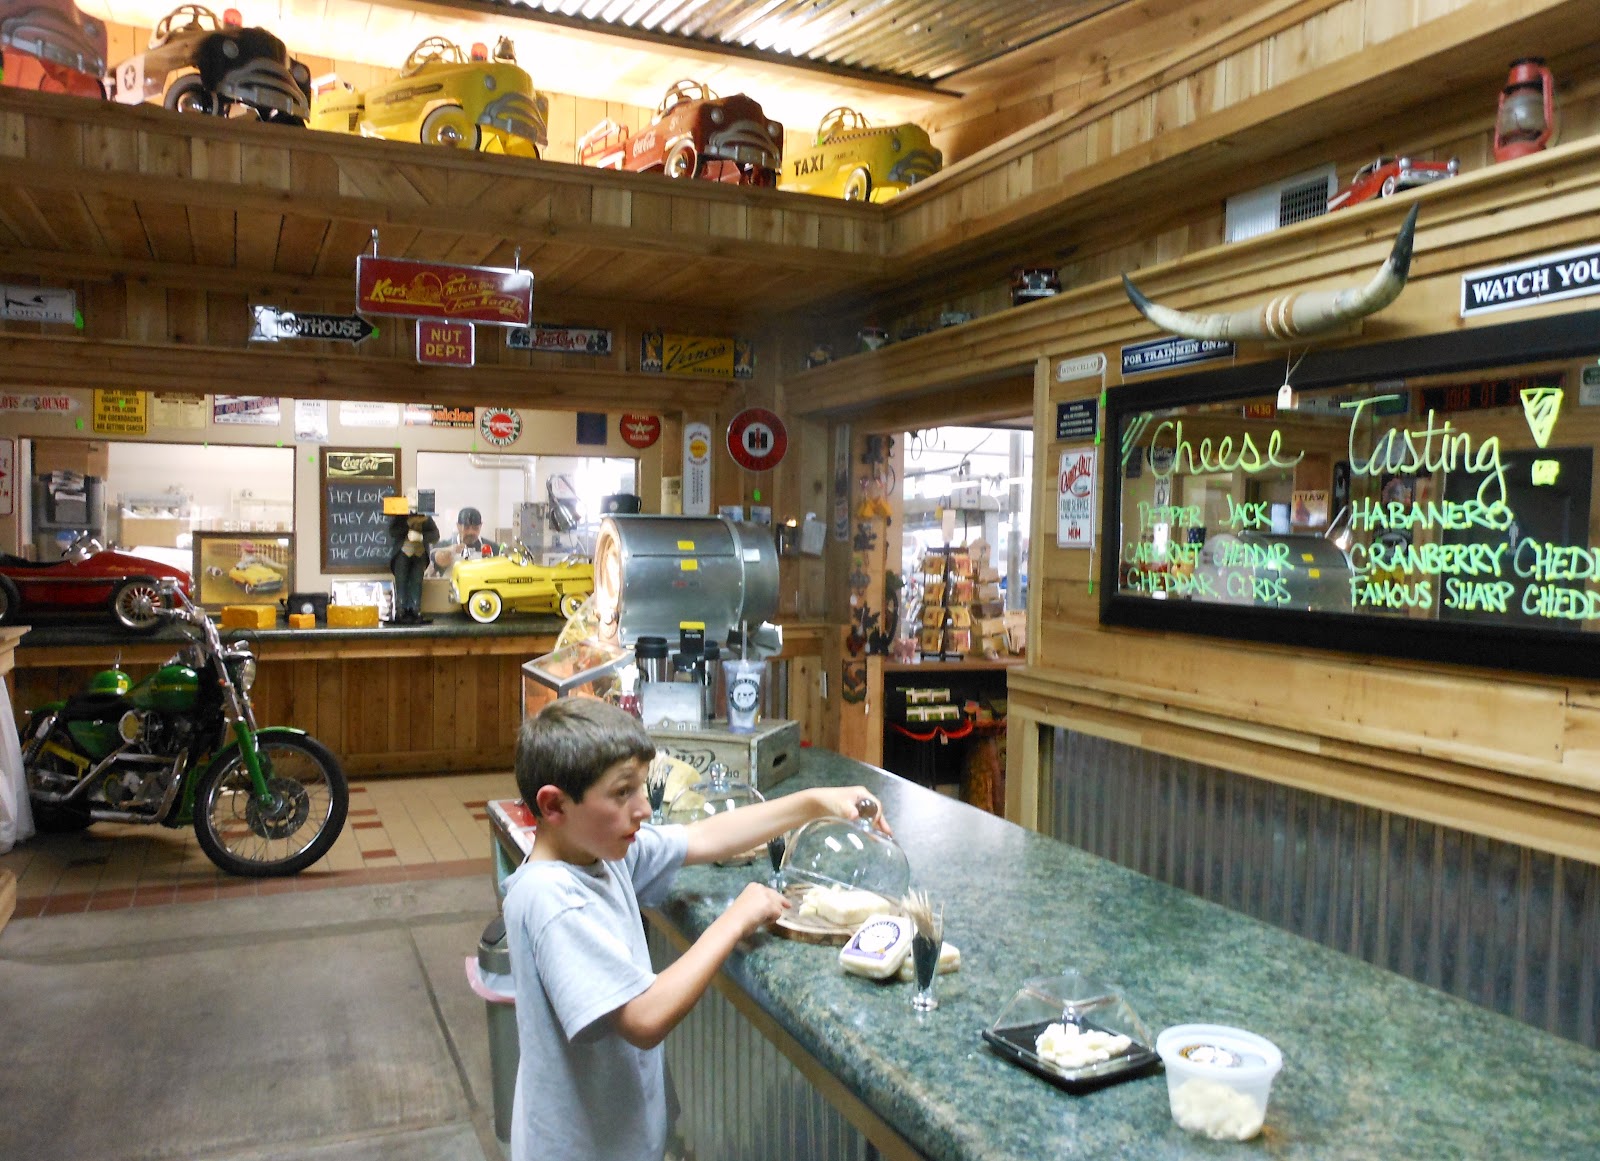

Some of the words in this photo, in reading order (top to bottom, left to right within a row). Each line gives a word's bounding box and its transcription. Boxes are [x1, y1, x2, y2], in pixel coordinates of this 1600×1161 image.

[793, 154, 825, 176] TAXI
[1472, 268, 1549, 304] WATCH
[281, 317, 362, 337] OUTHOUSE
[431, 328, 462, 342] NUT
[425, 344, 466, 359] DEPT.
[1123, 354, 1143, 366] FOR
[482, 426, 520, 446] AIRCRAFT
[1150, 419, 1305, 479] Cheese
[1339, 393, 1514, 512] Tasting
[341, 455, 381, 471] Coca-Cola
[330, 511, 364, 525] THEY
[1218, 493, 1275, 529] JACK
[1352, 496, 1514, 532] HABANERO
[330, 531, 388, 545] CUTTING
[1067, 527, 1081, 540] MOM
[329, 547, 350, 560] THE
[1212, 540, 1296, 571] CHEDDAR
[1350, 541, 1509, 578] CRANBERRY
[1126, 567, 1220, 599] CHEDDAR
[1226, 570, 1292, 604] CURDS
[1349, 574, 1434, 609] FAMOUS
[1444, 577, 1516, 614] SHARP
